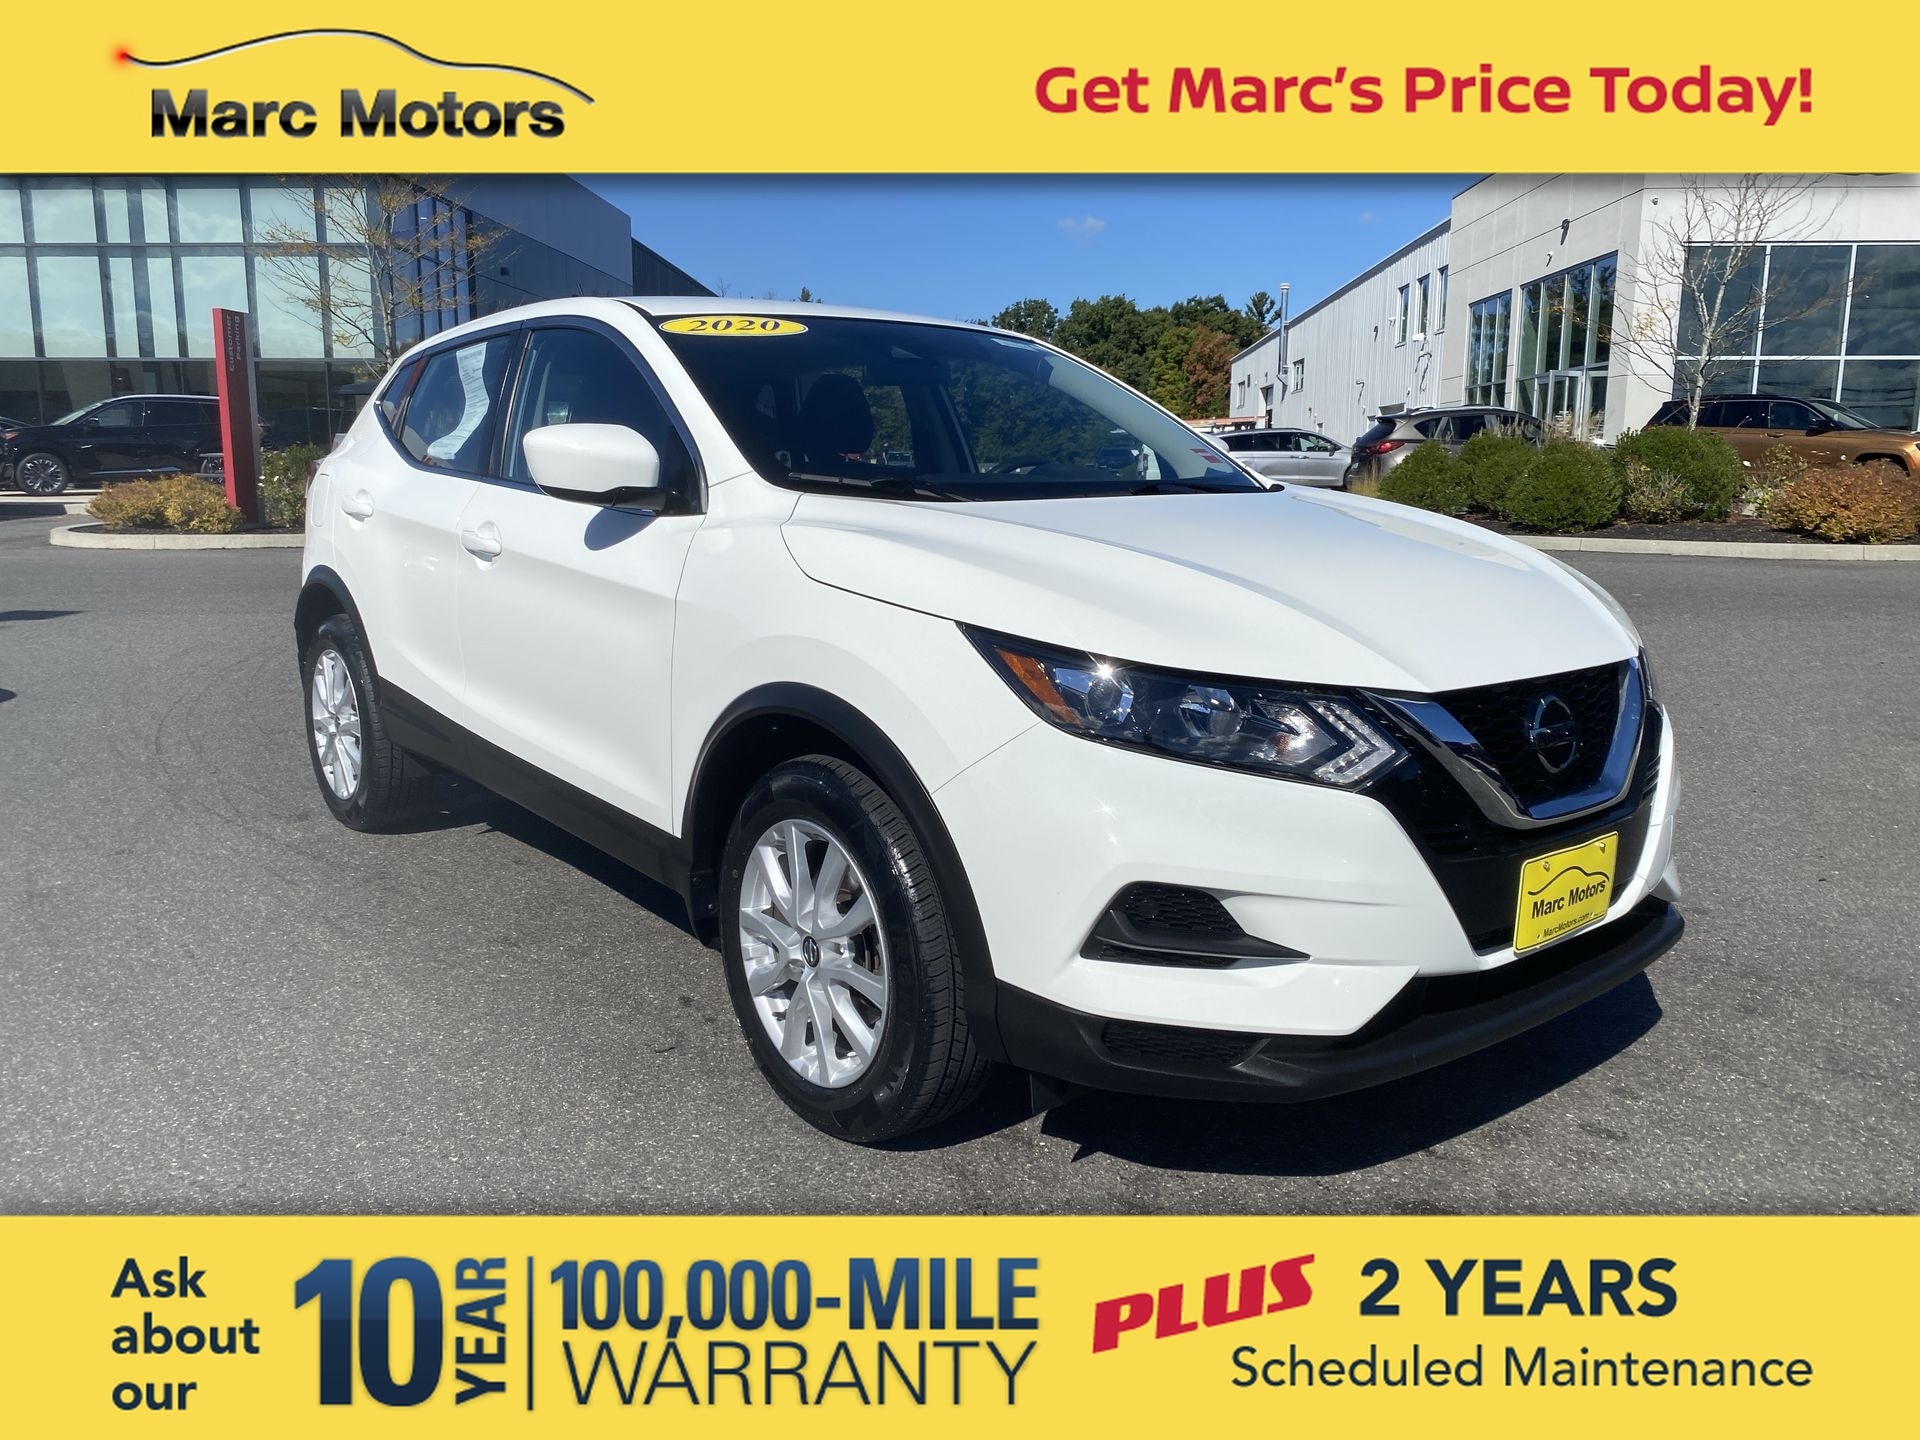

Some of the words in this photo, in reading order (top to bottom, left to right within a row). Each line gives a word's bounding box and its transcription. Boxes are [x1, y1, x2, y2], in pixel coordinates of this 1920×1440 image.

[688, 319, 780, 332] 2020
[1531, 896, 1565, 919] Marc
[1568, 880, 1606, 906] Motors
[1543, 914, 1589, 938] MarcMotors.com
